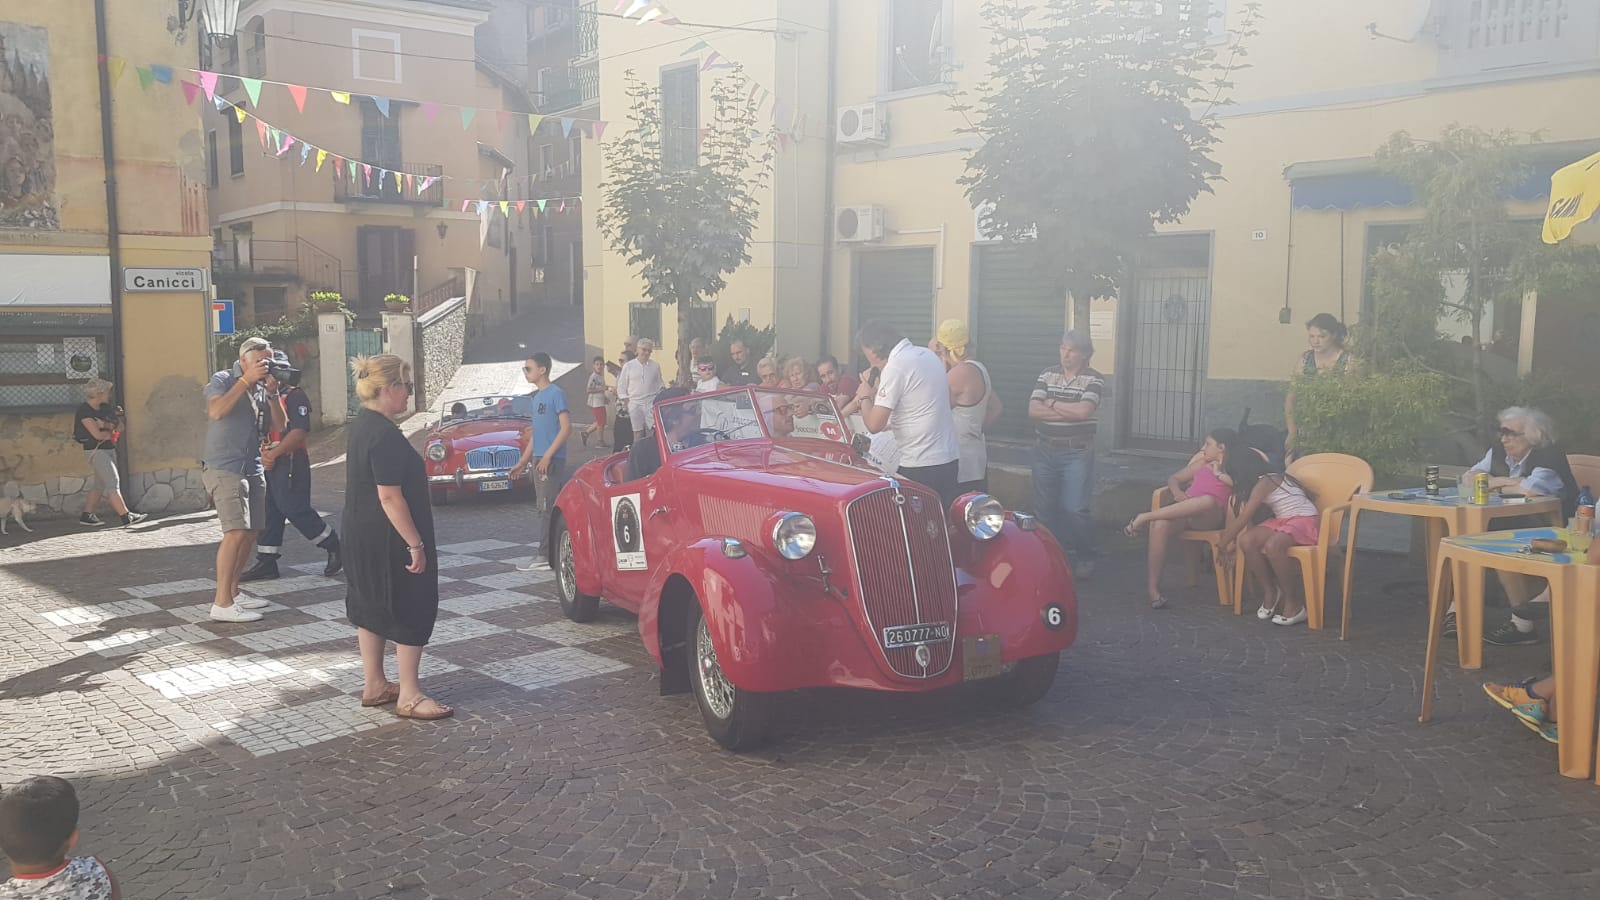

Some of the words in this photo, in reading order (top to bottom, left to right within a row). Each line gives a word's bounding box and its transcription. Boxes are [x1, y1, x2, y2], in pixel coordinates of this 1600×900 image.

[134, 275, 195, 288] Canicci
[623, 524, 632, 544] 6
[1048, 607, 1061, 625] 6
[888, 627, 931, 645] 260777
